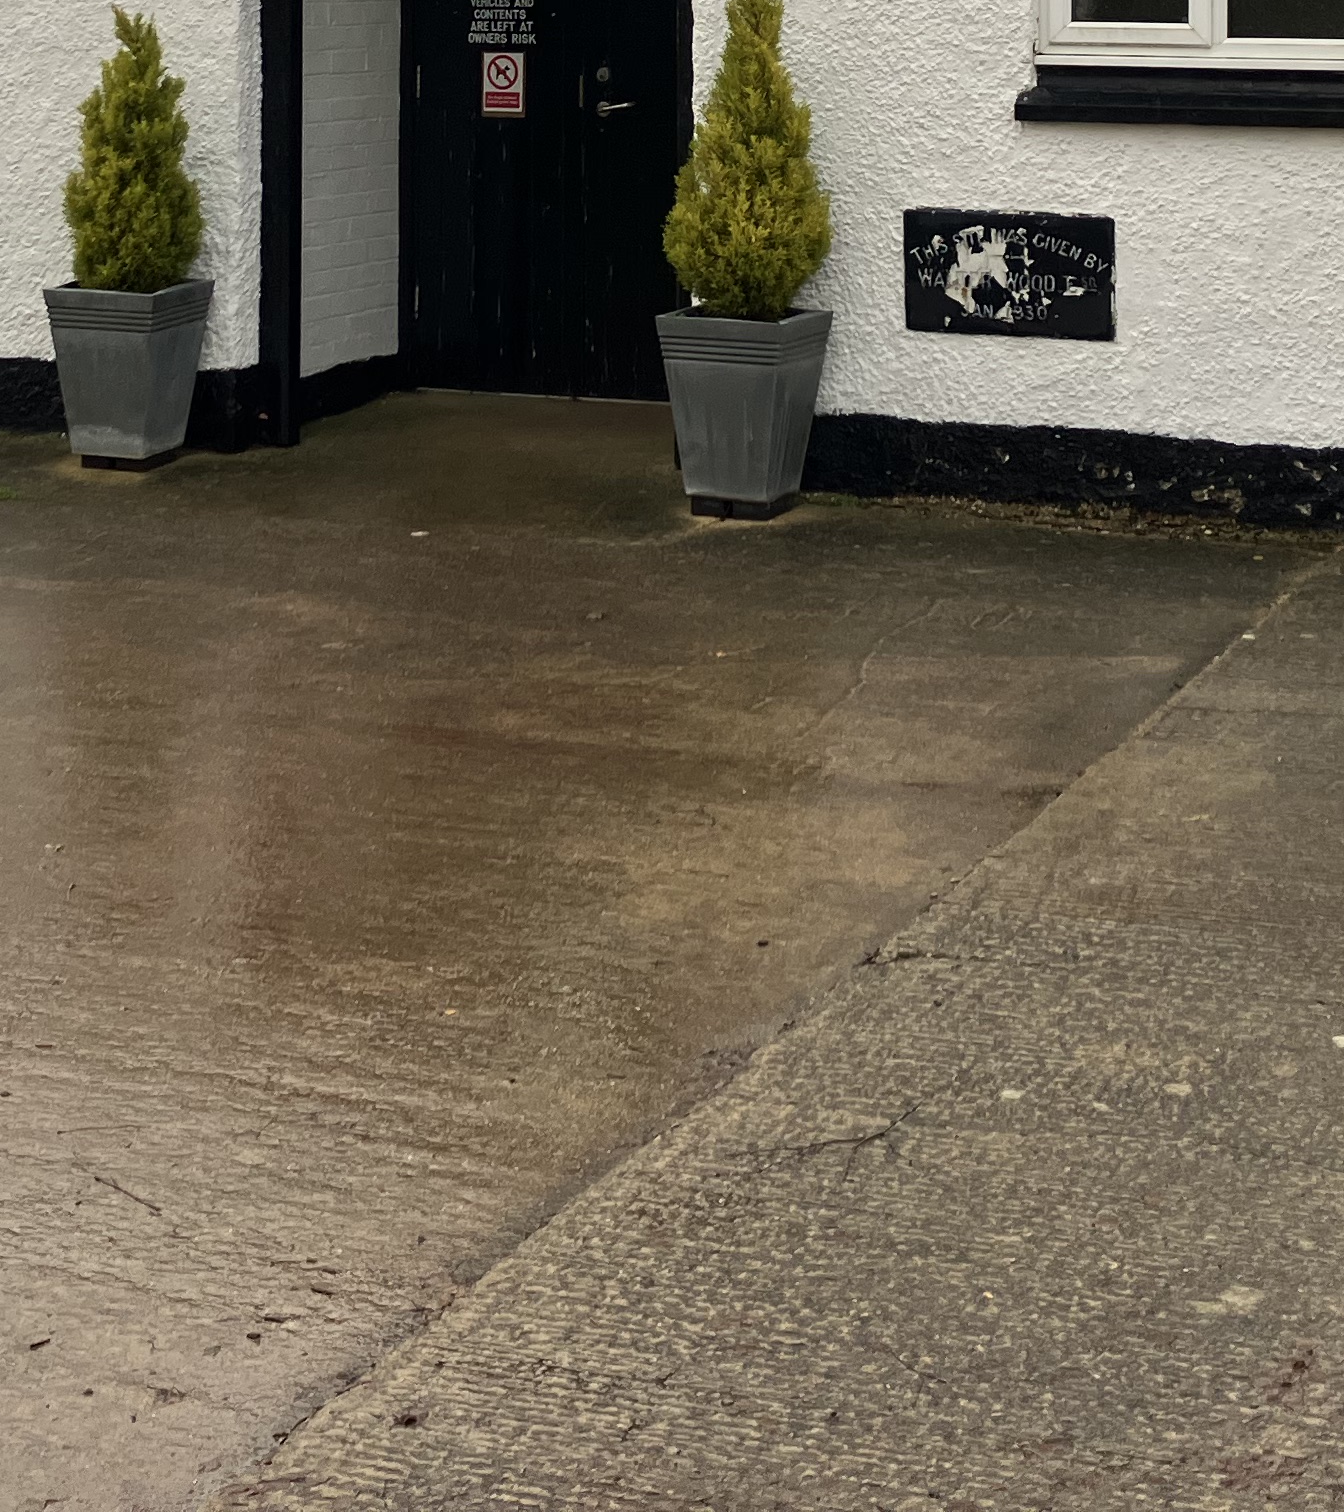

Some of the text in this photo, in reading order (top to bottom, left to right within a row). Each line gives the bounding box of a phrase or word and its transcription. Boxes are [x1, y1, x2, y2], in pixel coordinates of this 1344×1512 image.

[474, 9, 527, 20] CONTENTS
[470, 21, 534, 32] ARE LEFT AT
[468, 33, 536, 44] OWNERS RISK
[1032, 233, 1082, 261] GIVEN
[1083, 253, 1109, 273] BY
[917, 268, 992, 289] WAR
[1006, 272, 1056, 292] WOOD
